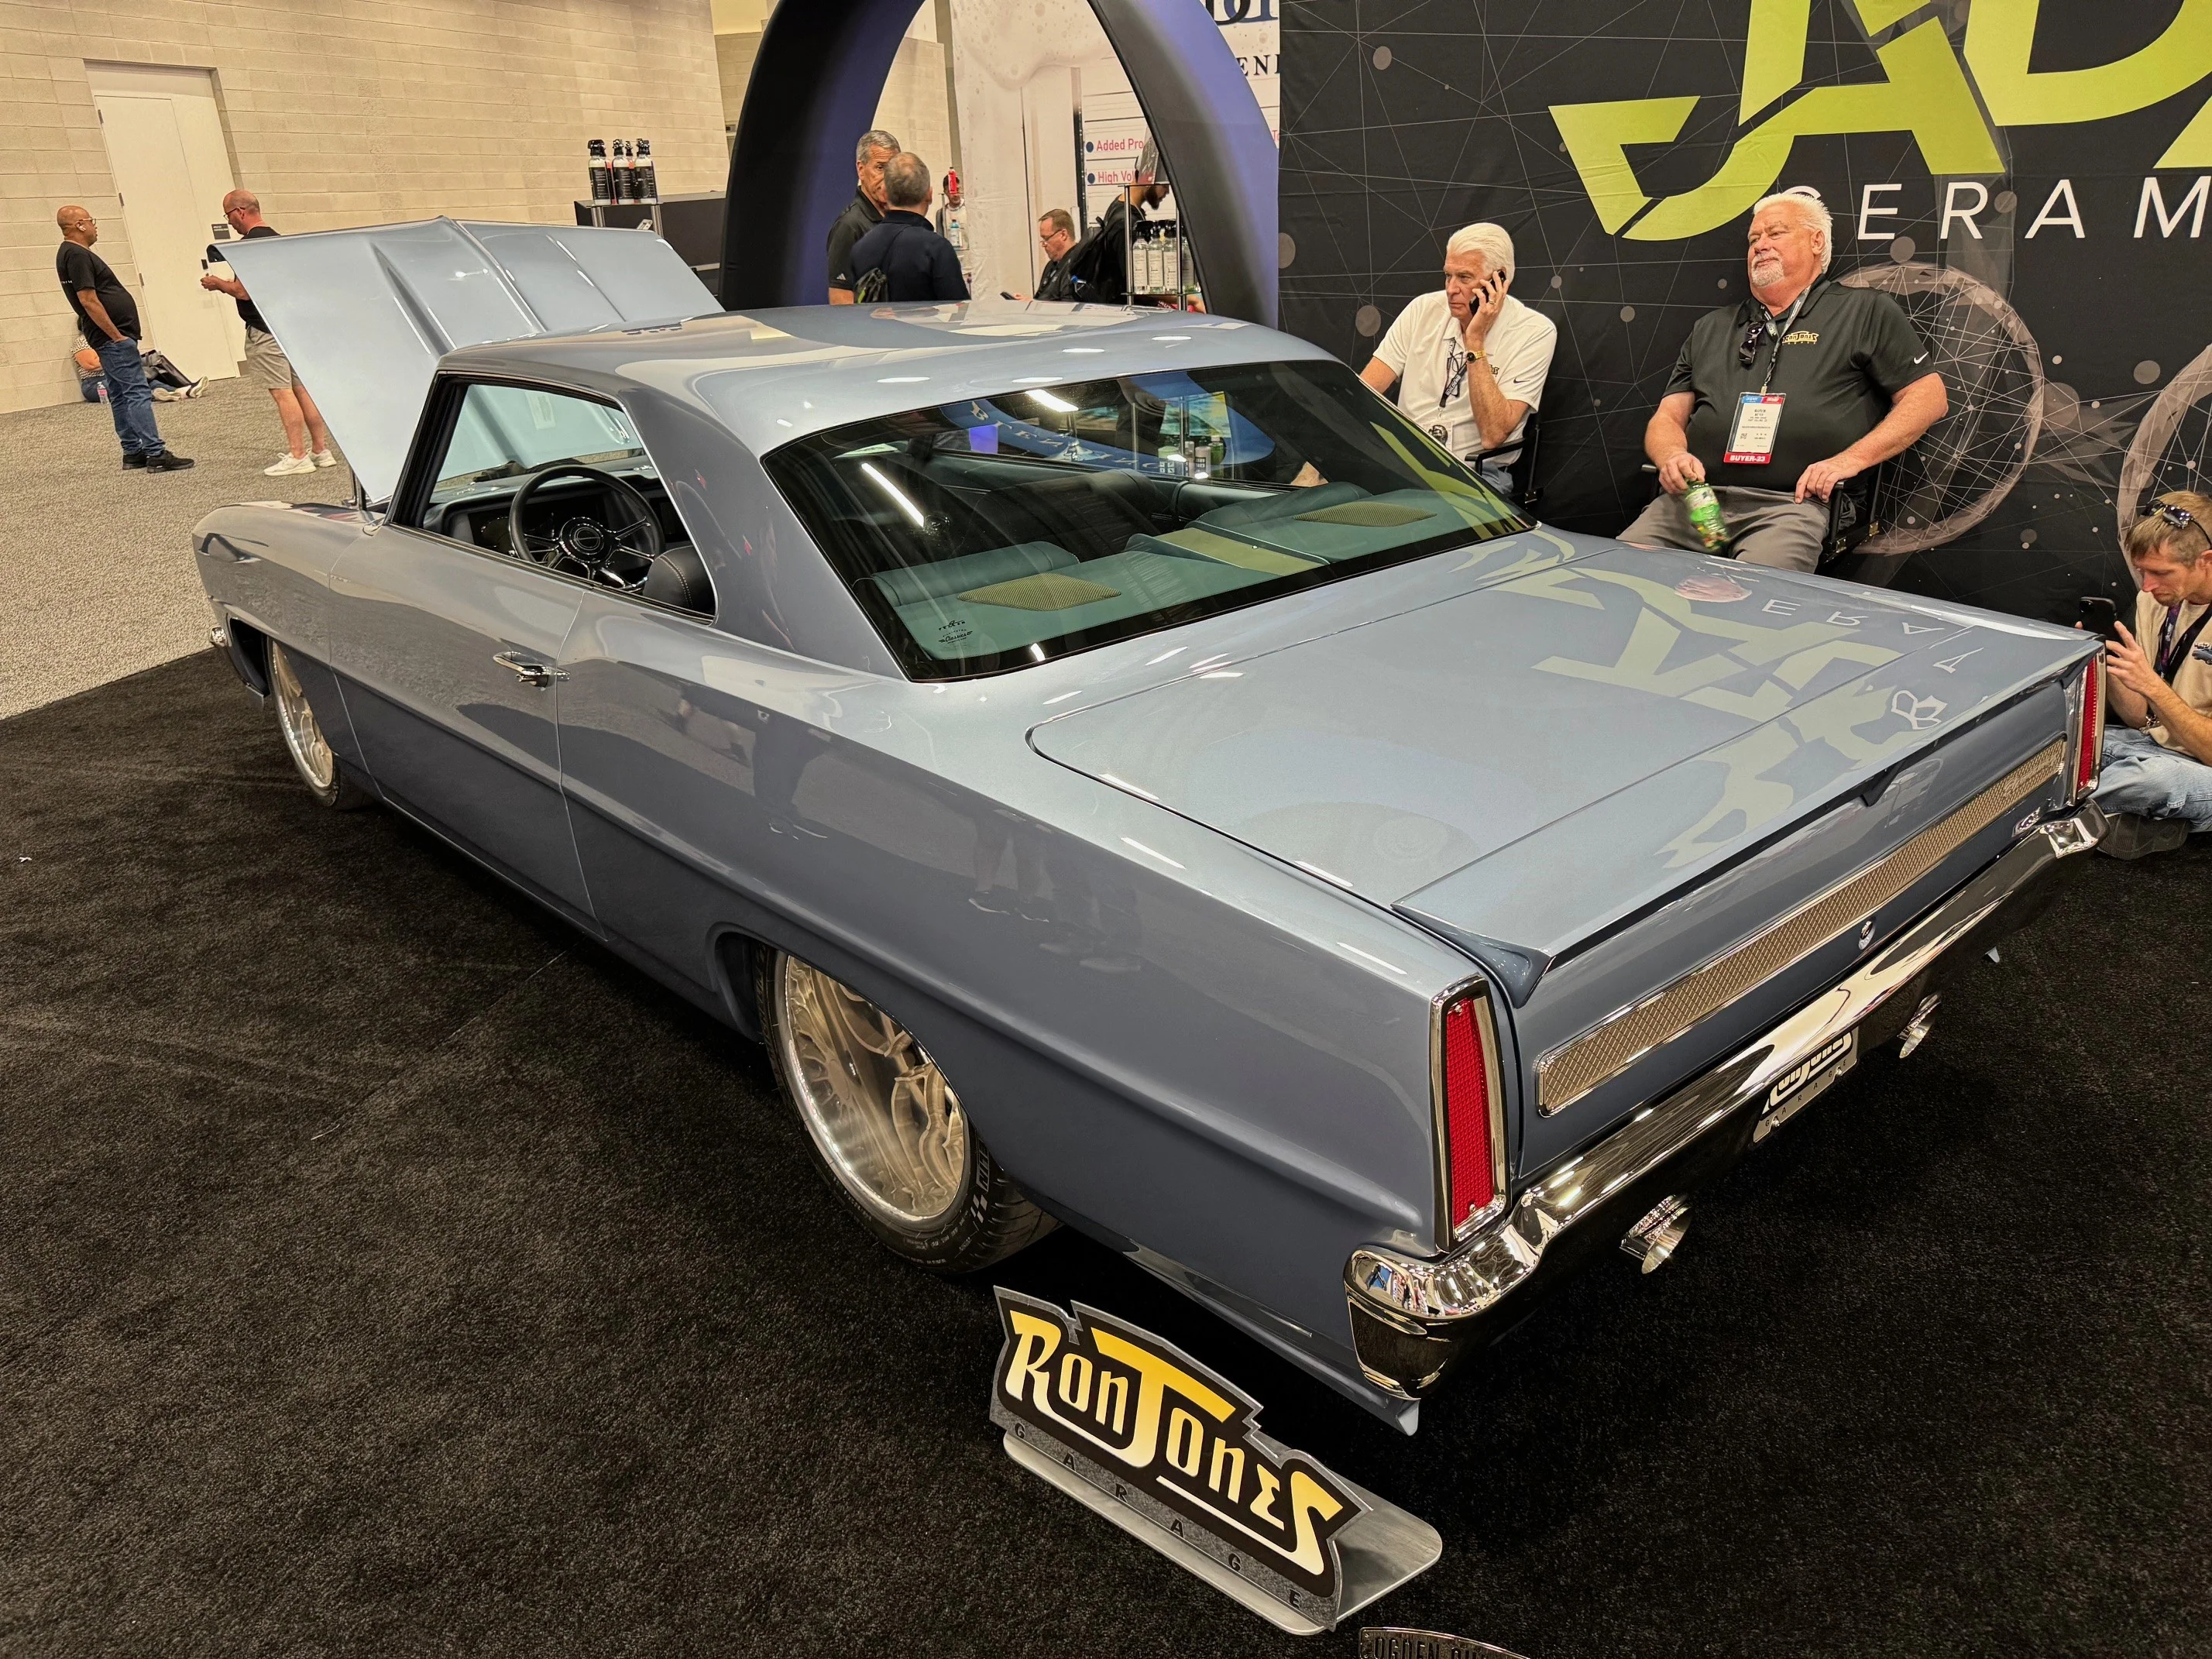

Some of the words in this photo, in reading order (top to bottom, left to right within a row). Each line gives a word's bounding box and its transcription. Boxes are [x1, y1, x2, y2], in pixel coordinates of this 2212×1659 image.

[1097, 139, 1125, 151] Added
[1097, 171, 1118, 184] High
[1781, 175, 2212, 240] ERAM
[1013, 1422, 1303, 1609] GARAGE
